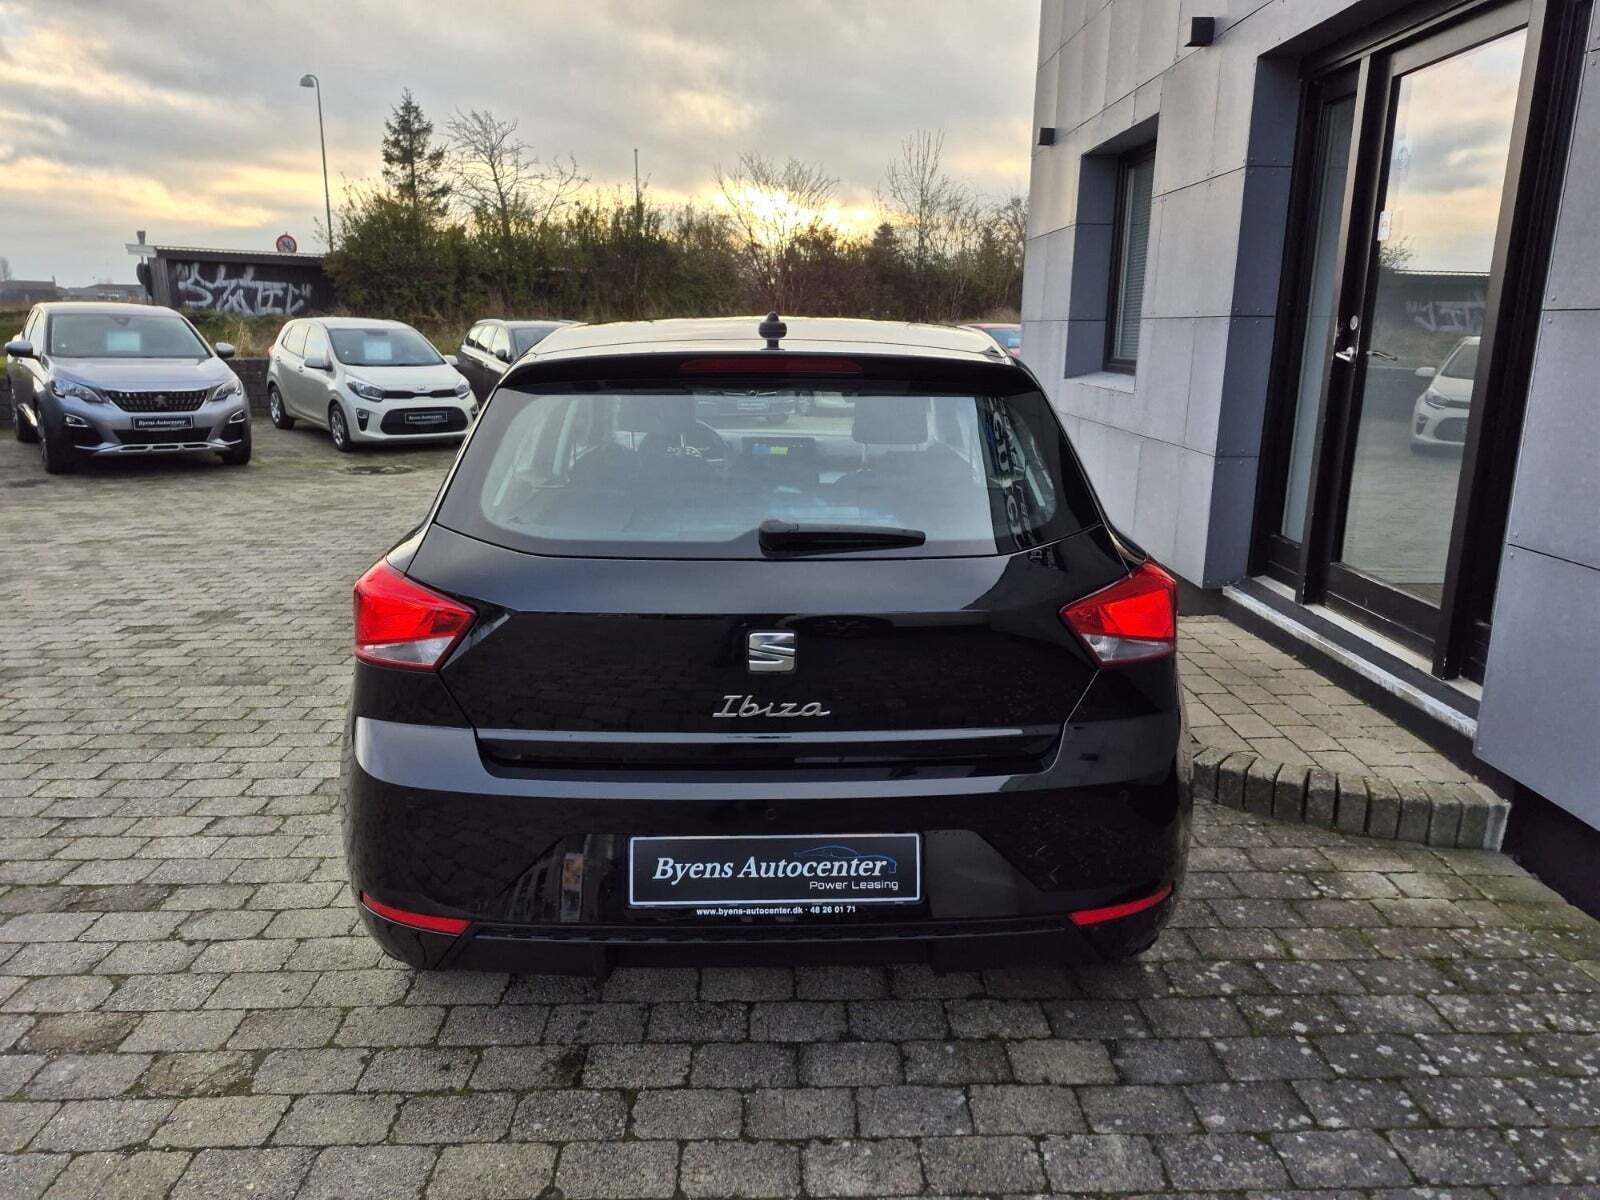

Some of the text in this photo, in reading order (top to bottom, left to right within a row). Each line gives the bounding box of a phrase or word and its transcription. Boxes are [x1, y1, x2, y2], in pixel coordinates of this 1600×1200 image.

[712, 695, 831, 718] Ibiza
[652, 856, 888, 885] Byens Autocenter
[809, 878, 899, 891] Power Leasing
[696, 906, 804, 917] www.byens-autocenter.dk
[834, 905, 844, 913] 01
[846, 905, 856, 913] 71
